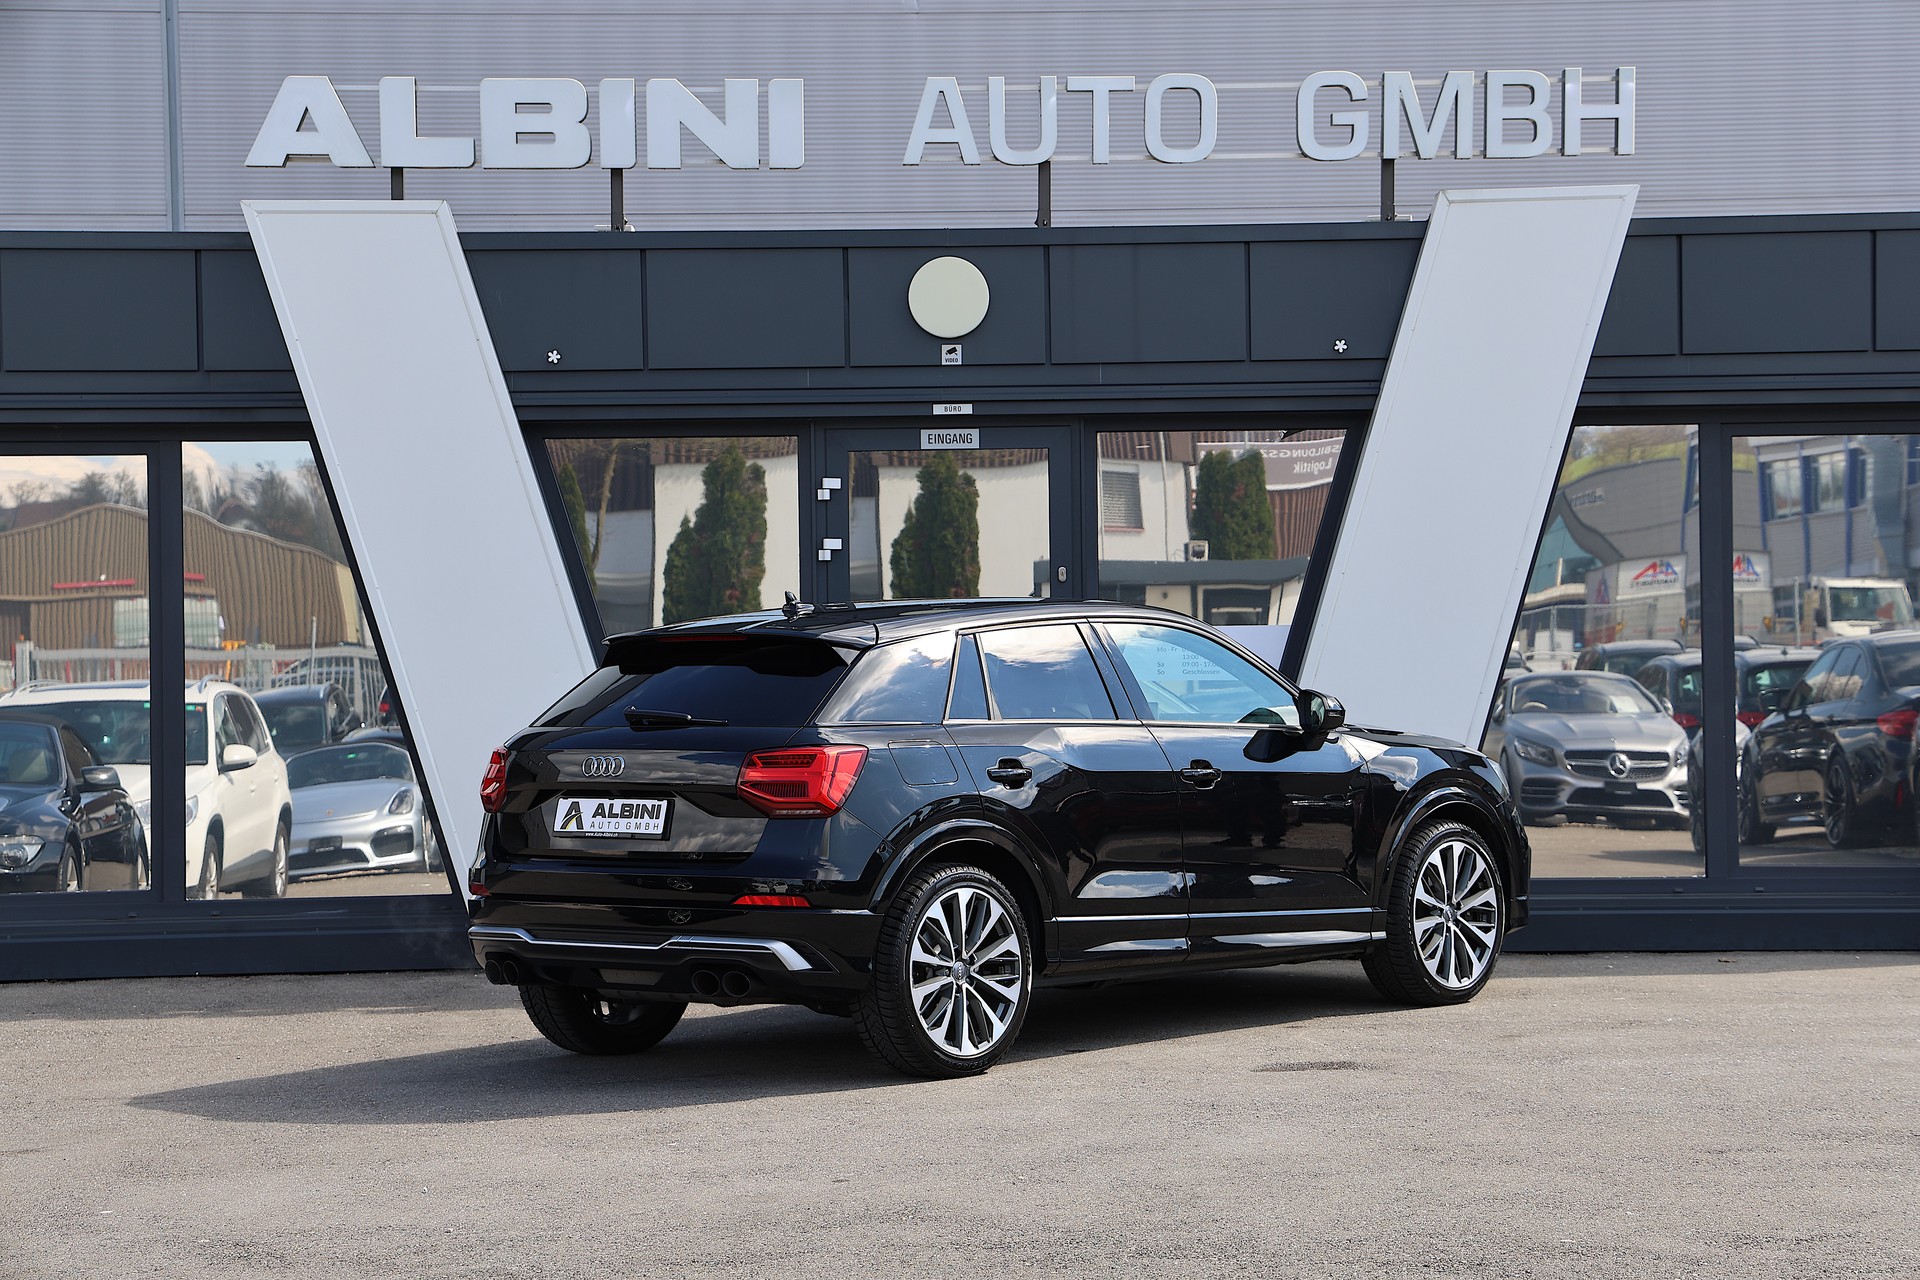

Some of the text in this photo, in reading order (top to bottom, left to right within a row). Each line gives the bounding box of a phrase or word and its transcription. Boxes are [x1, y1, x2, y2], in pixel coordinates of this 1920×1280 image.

[244, 66, 1636, 169] ALBINI AUTO GMBH
[927, 433, 973, 445] EINGANG
[591, 803, 663, 820] ALBINI
[590, 821, 660, 831] AUTO GMBH
